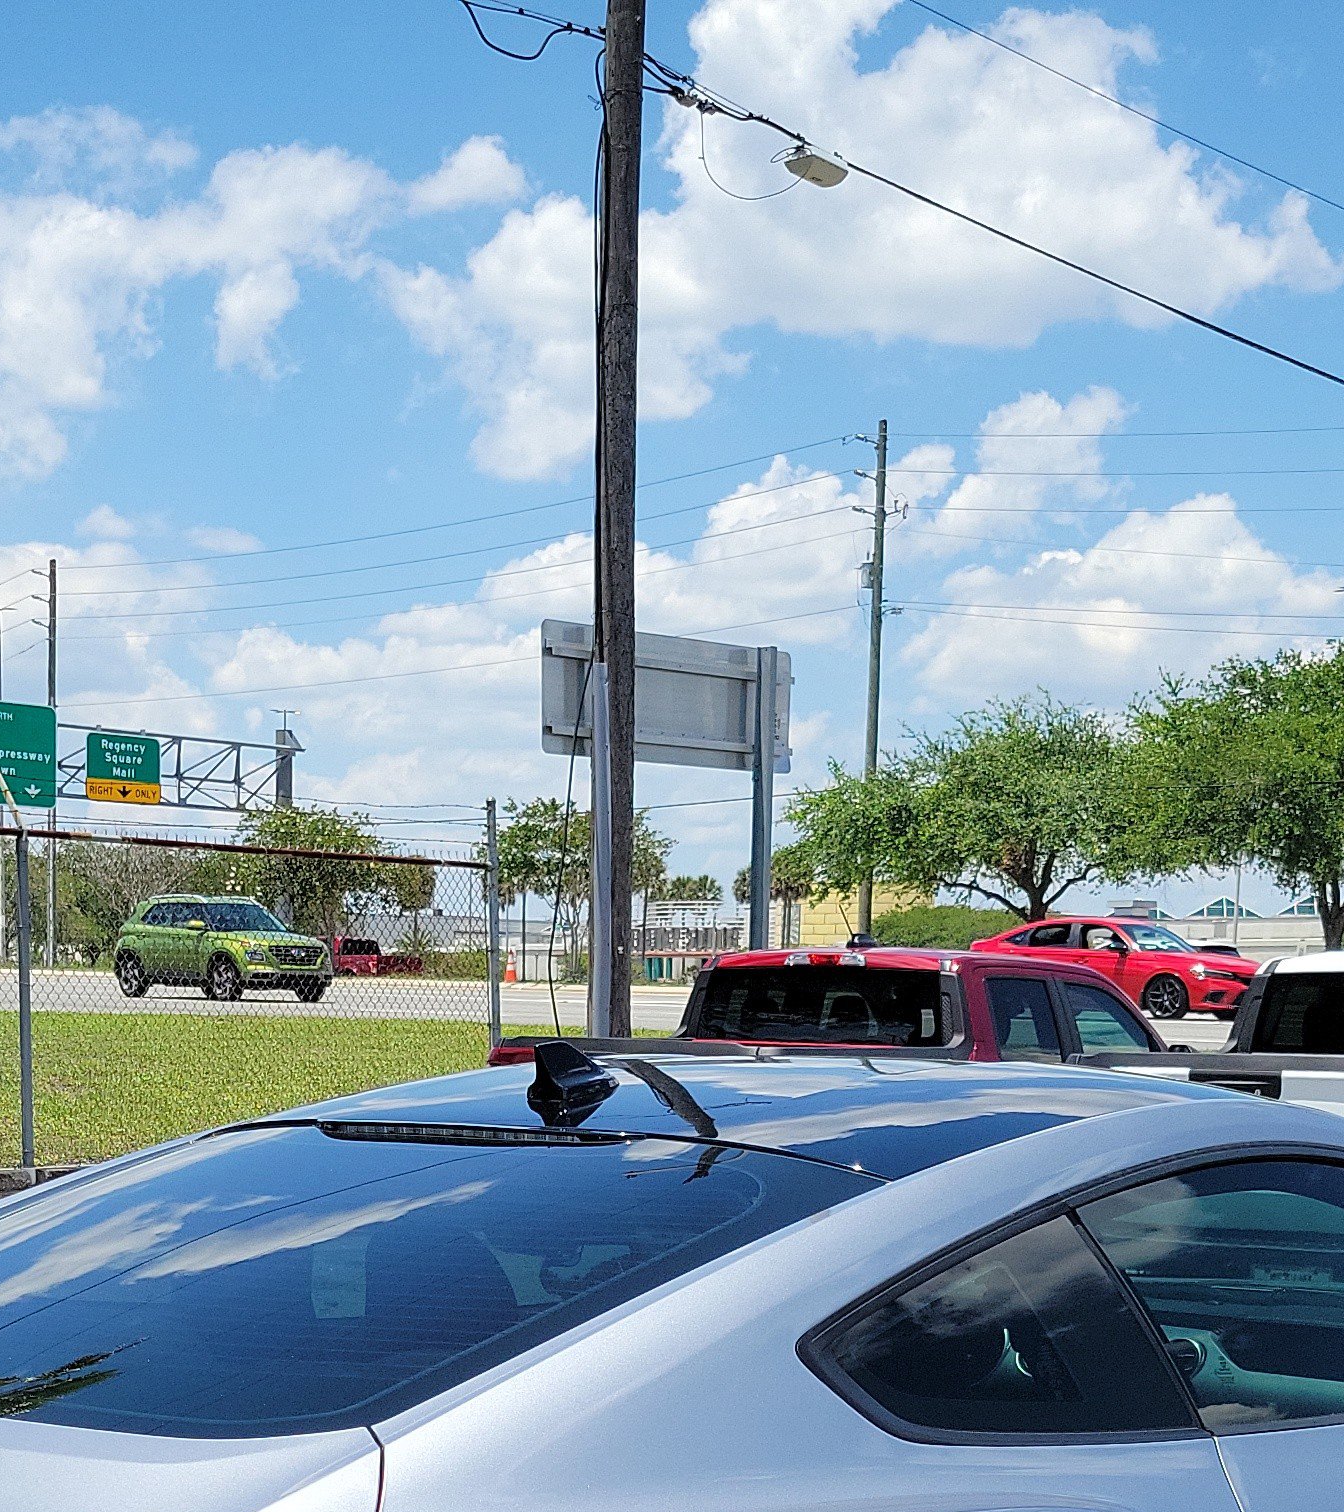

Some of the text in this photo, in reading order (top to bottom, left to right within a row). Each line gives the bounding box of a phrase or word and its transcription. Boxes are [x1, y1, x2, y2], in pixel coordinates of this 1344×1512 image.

[101, 739, 146, 755] Regency
[104, 752, 143, 765] Square
[112, 766, 135, 778] Mall
[89, 785, 157, 799] RIGHT ONLY
